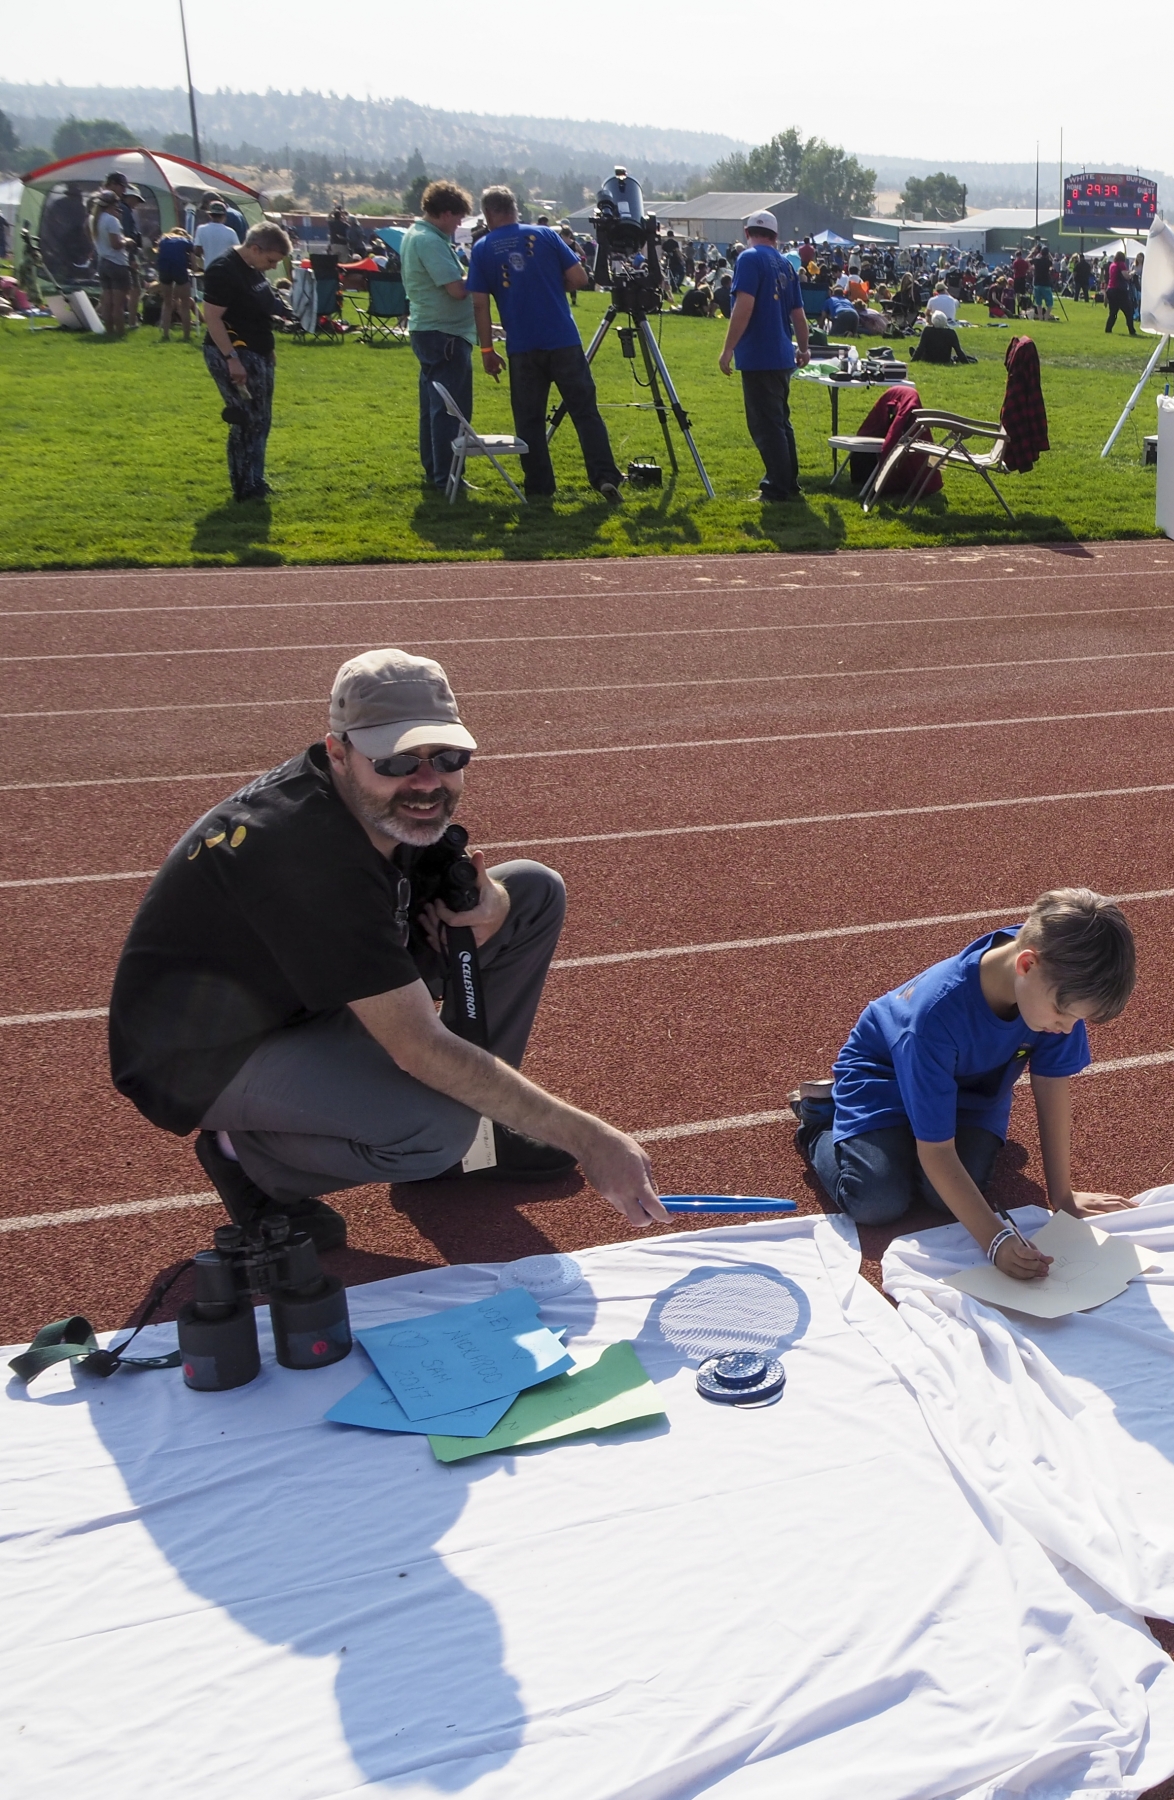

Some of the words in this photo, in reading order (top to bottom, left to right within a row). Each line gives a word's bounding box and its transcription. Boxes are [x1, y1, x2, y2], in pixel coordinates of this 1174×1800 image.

[1069, 174, 1095, 184] WHITE
[1126, 175, 1156, 188] BUFFALO
[1072, 189, 1079, 199] 8
[1086, 184, 1118, 196] 29:39
[461, 962, 477, 1020] CELESTRON
[478, 1306, 516, 1333] JOEY
[392, 1369, 434, 1400] 2017
[421, 1359, 453, 1385] SAM
